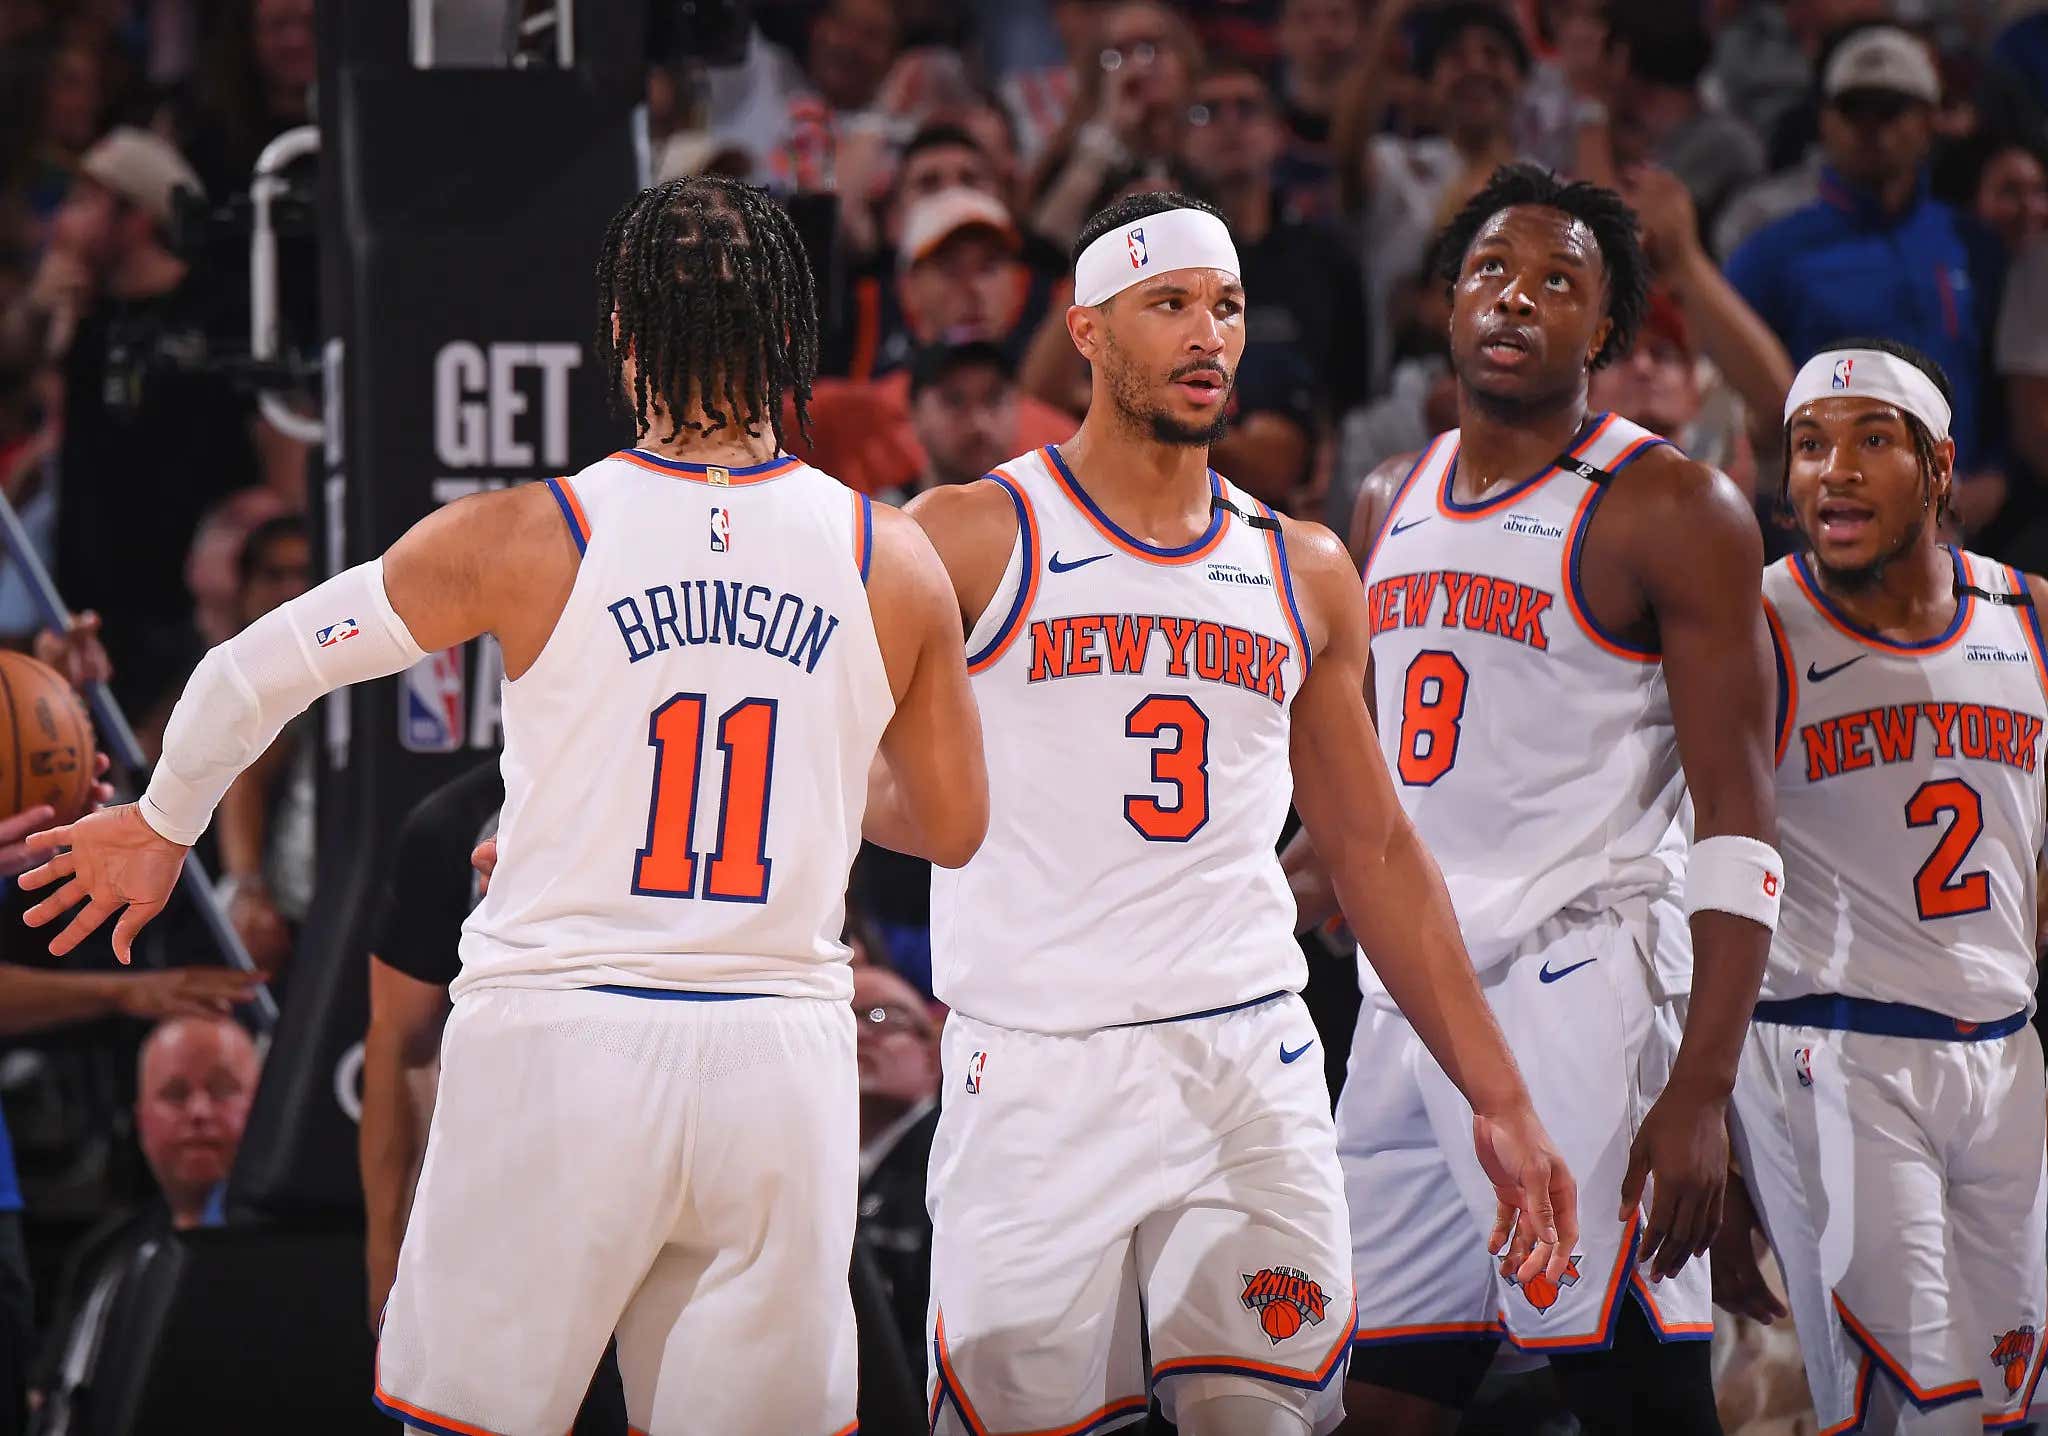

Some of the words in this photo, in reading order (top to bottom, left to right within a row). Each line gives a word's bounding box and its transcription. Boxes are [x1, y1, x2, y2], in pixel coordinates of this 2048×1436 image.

[434, 341, 582, 467] GET
[1579, 463, 1594, 478] 12
[1503, 521, 1526, 532] abu
[1528, 524, 1563, 538] dhabi
[1208, 570, 1233, 583] abu
[1235, 573, 1272, 586] dhabi
[1368, 571, 1440, 640] NEW
[1441, 570, 1554, 653] YORK
[607, 580, 840, 674] BRUNSON
[1027, 613, 1154, 684] NEW
[1158, 614, 1291, 707] YORK
[1397, 649, 1470, 787] 8
[1801, 703, 1921, 783] NEW
[1922, 702, 2044, 774] YORK
[630, 691, 779, 904] 11
[1124, 693, 1210, 843] 3
[1904, 777, 1992, 921] 2
[1241, 1269, 1325, 1322] KNICKS
[1273, 1266, 1291, 1276] NEW
